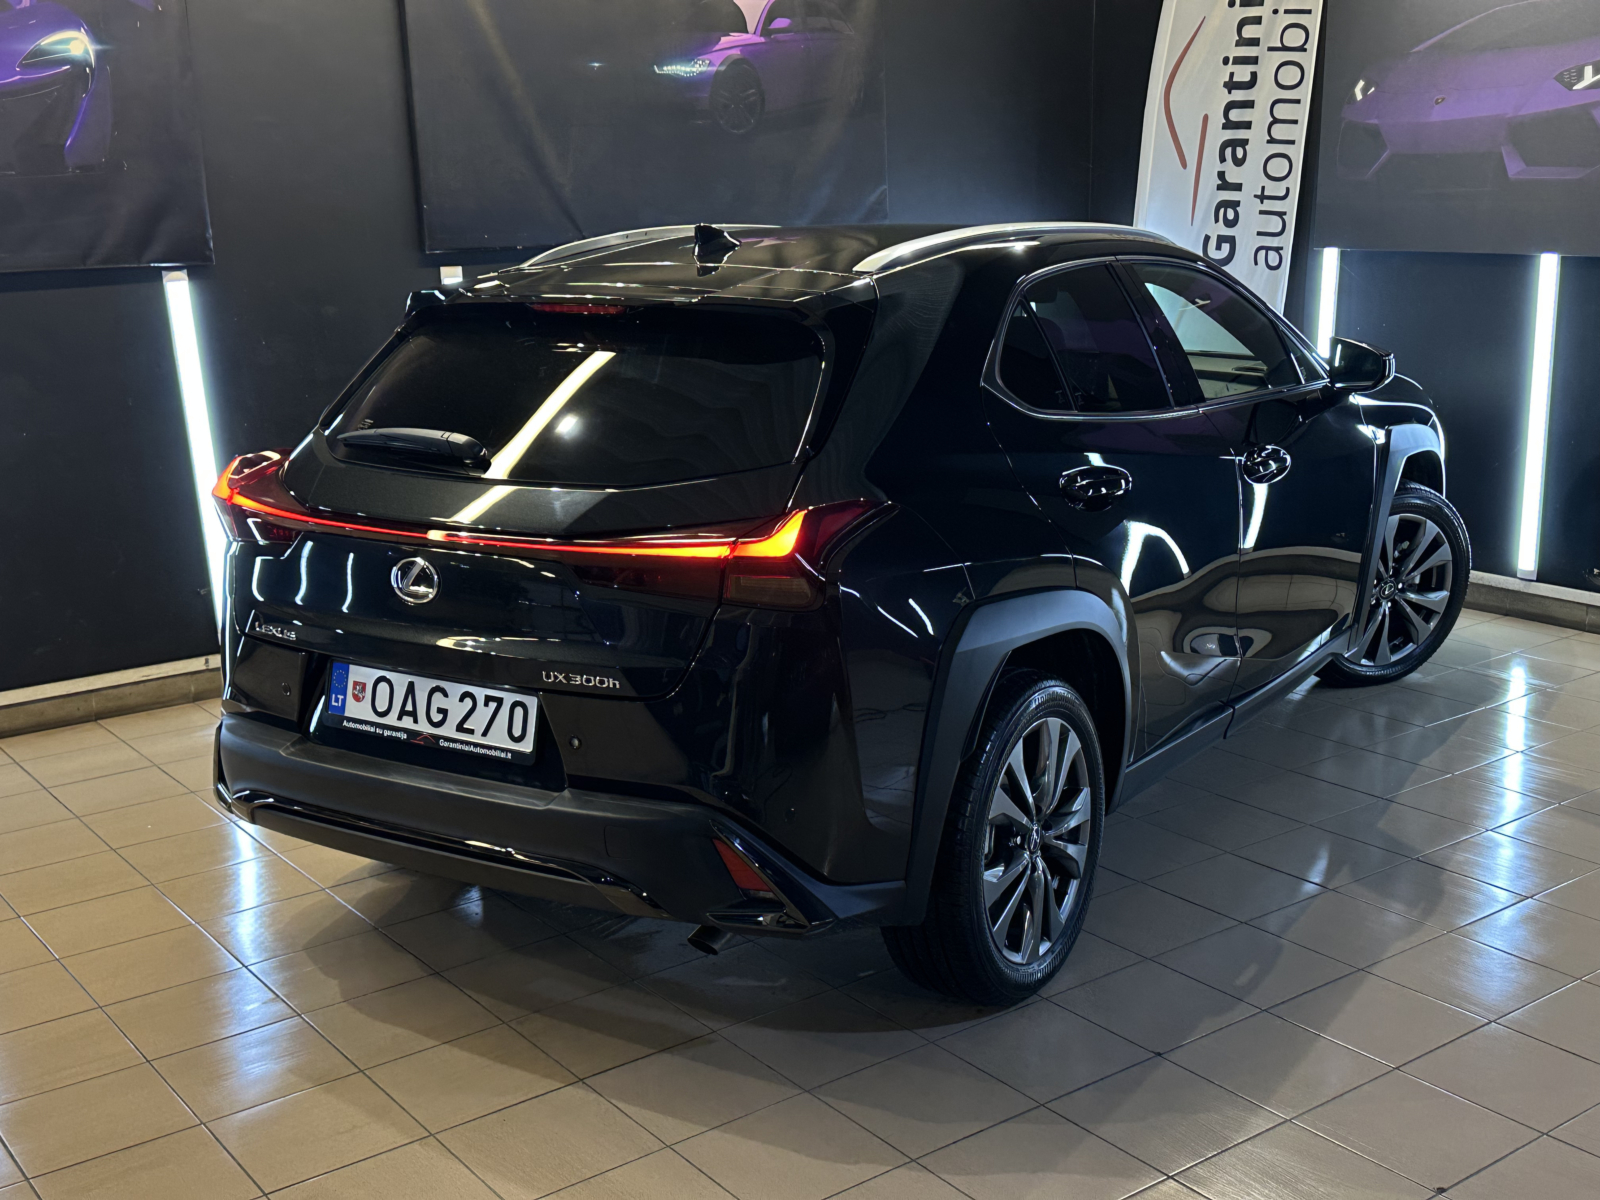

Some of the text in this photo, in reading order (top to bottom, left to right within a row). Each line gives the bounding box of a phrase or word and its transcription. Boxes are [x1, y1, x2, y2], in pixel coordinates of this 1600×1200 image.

[255, 621, 297, 640] LEXUS
[331, 694, 345, 707] LT
[342, 720, 376, 733] Automobiliai
[383, 729, 408, 740] garantija
